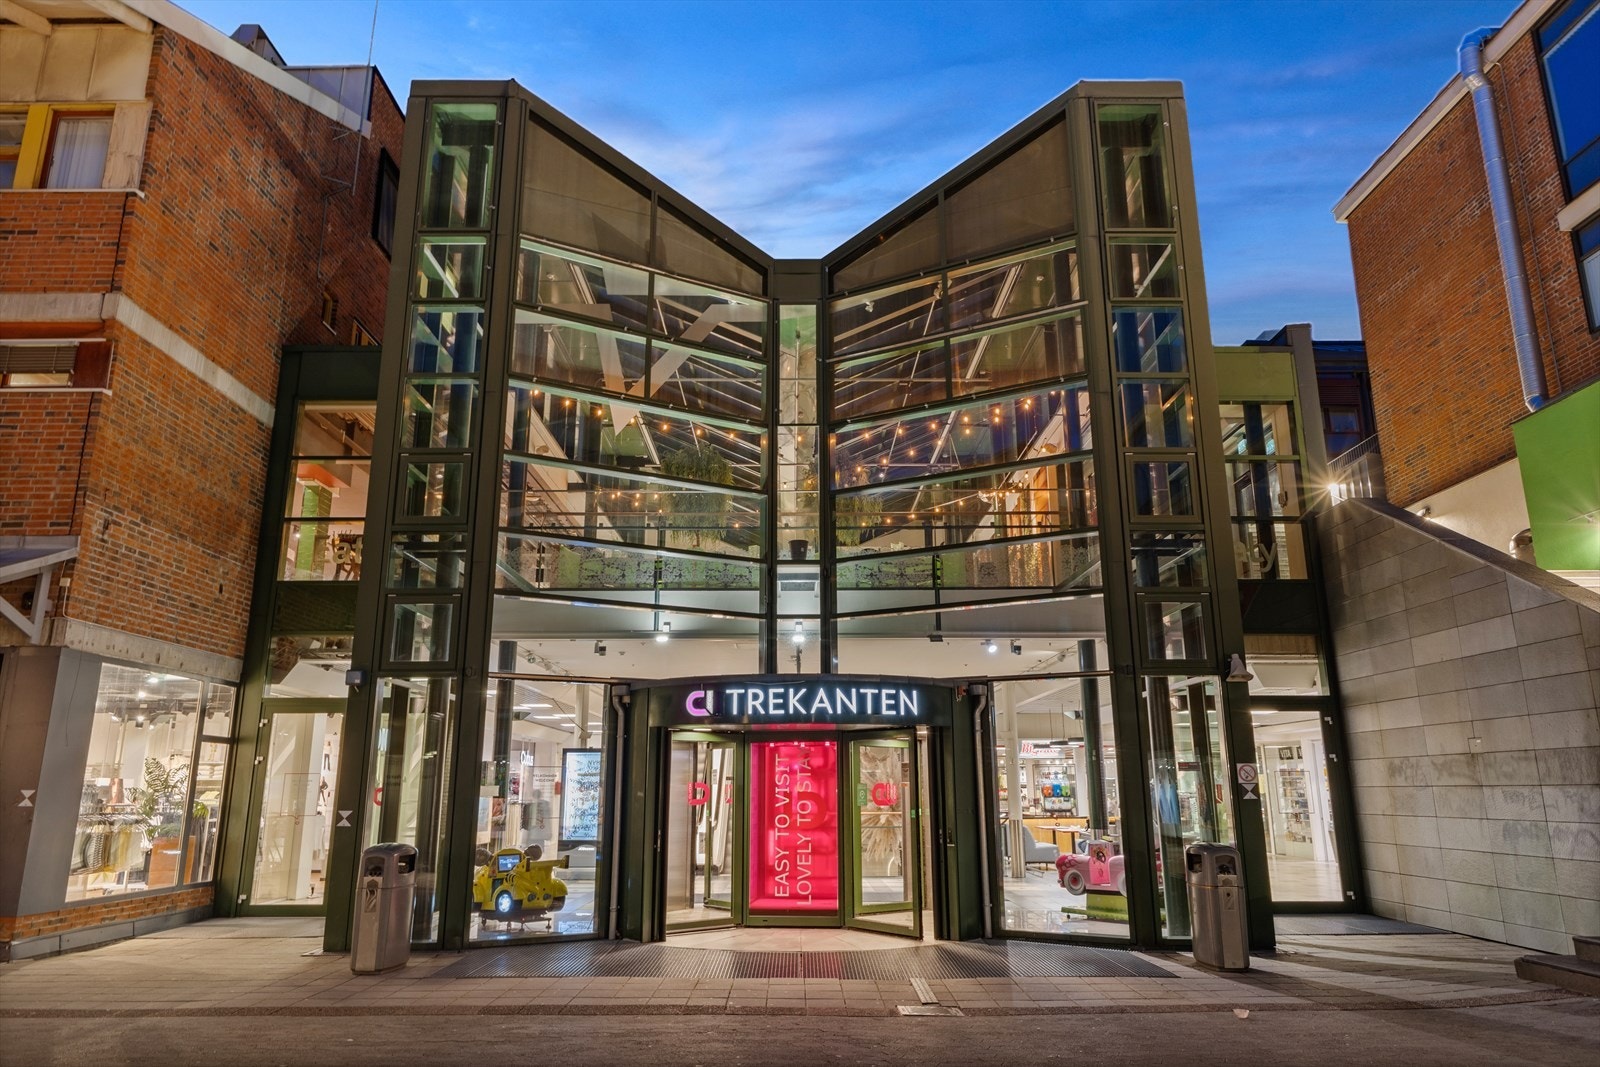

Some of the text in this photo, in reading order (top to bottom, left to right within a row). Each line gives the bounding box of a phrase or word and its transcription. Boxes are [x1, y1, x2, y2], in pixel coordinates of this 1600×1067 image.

[725, 687, 919, 716] TREKANTEN
[774, 754, 790, 897] EASY TO VISIT
[796, 800, 812, 826] TO
[796, 833, 812, 905] LOVELY
